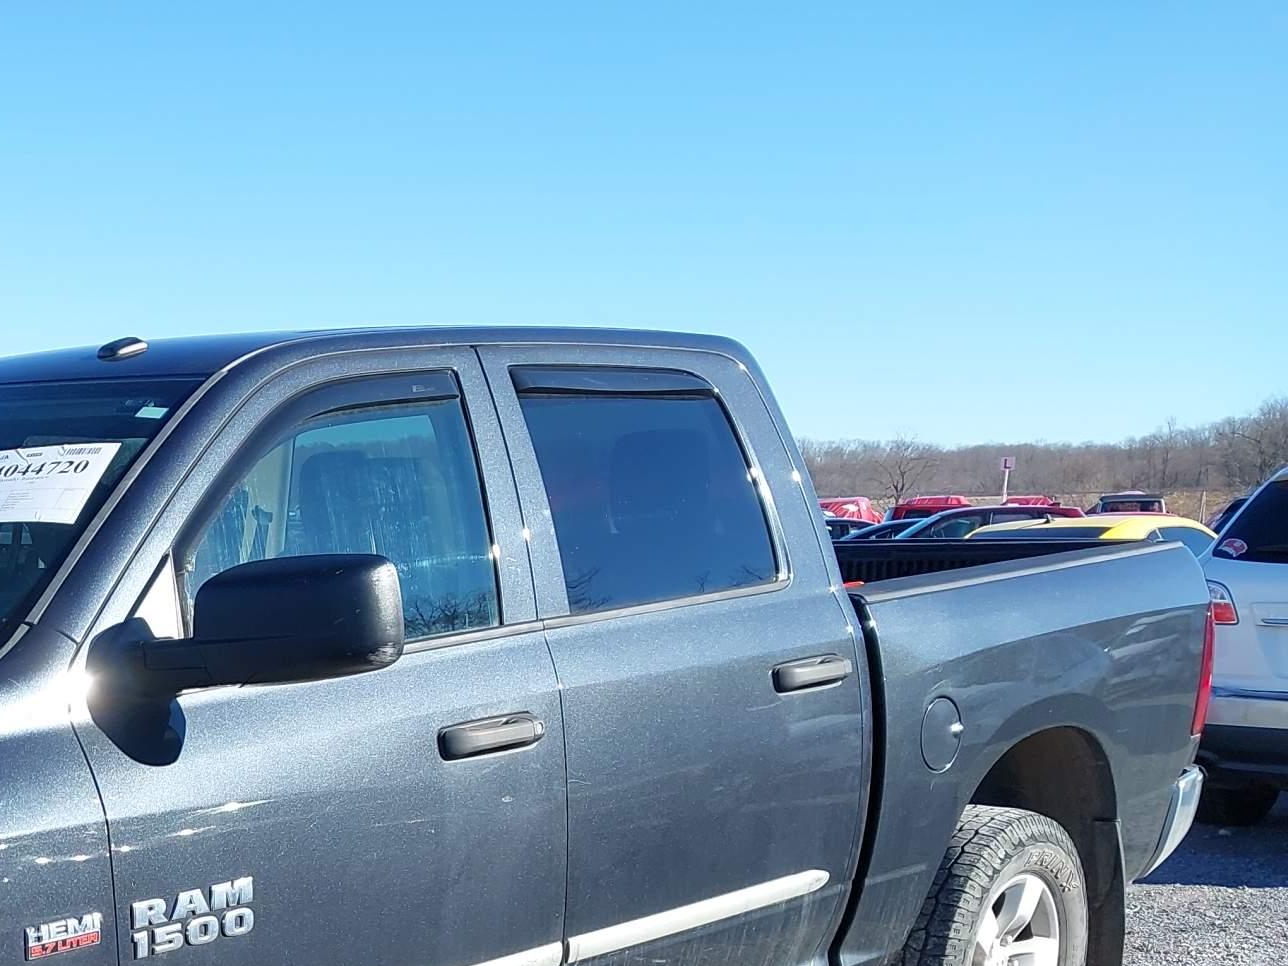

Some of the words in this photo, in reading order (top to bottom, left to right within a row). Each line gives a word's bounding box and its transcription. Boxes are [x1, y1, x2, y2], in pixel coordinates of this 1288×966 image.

[1003, 458, 1012, 469] L
[129, 876, 254, 930] RAM
[25, 912, 103, 946] HEMI
[31, 941, 56, 957] 5.7
[57, 931, 99, 952] LITER
[129, 907, 255, 959] 1500
